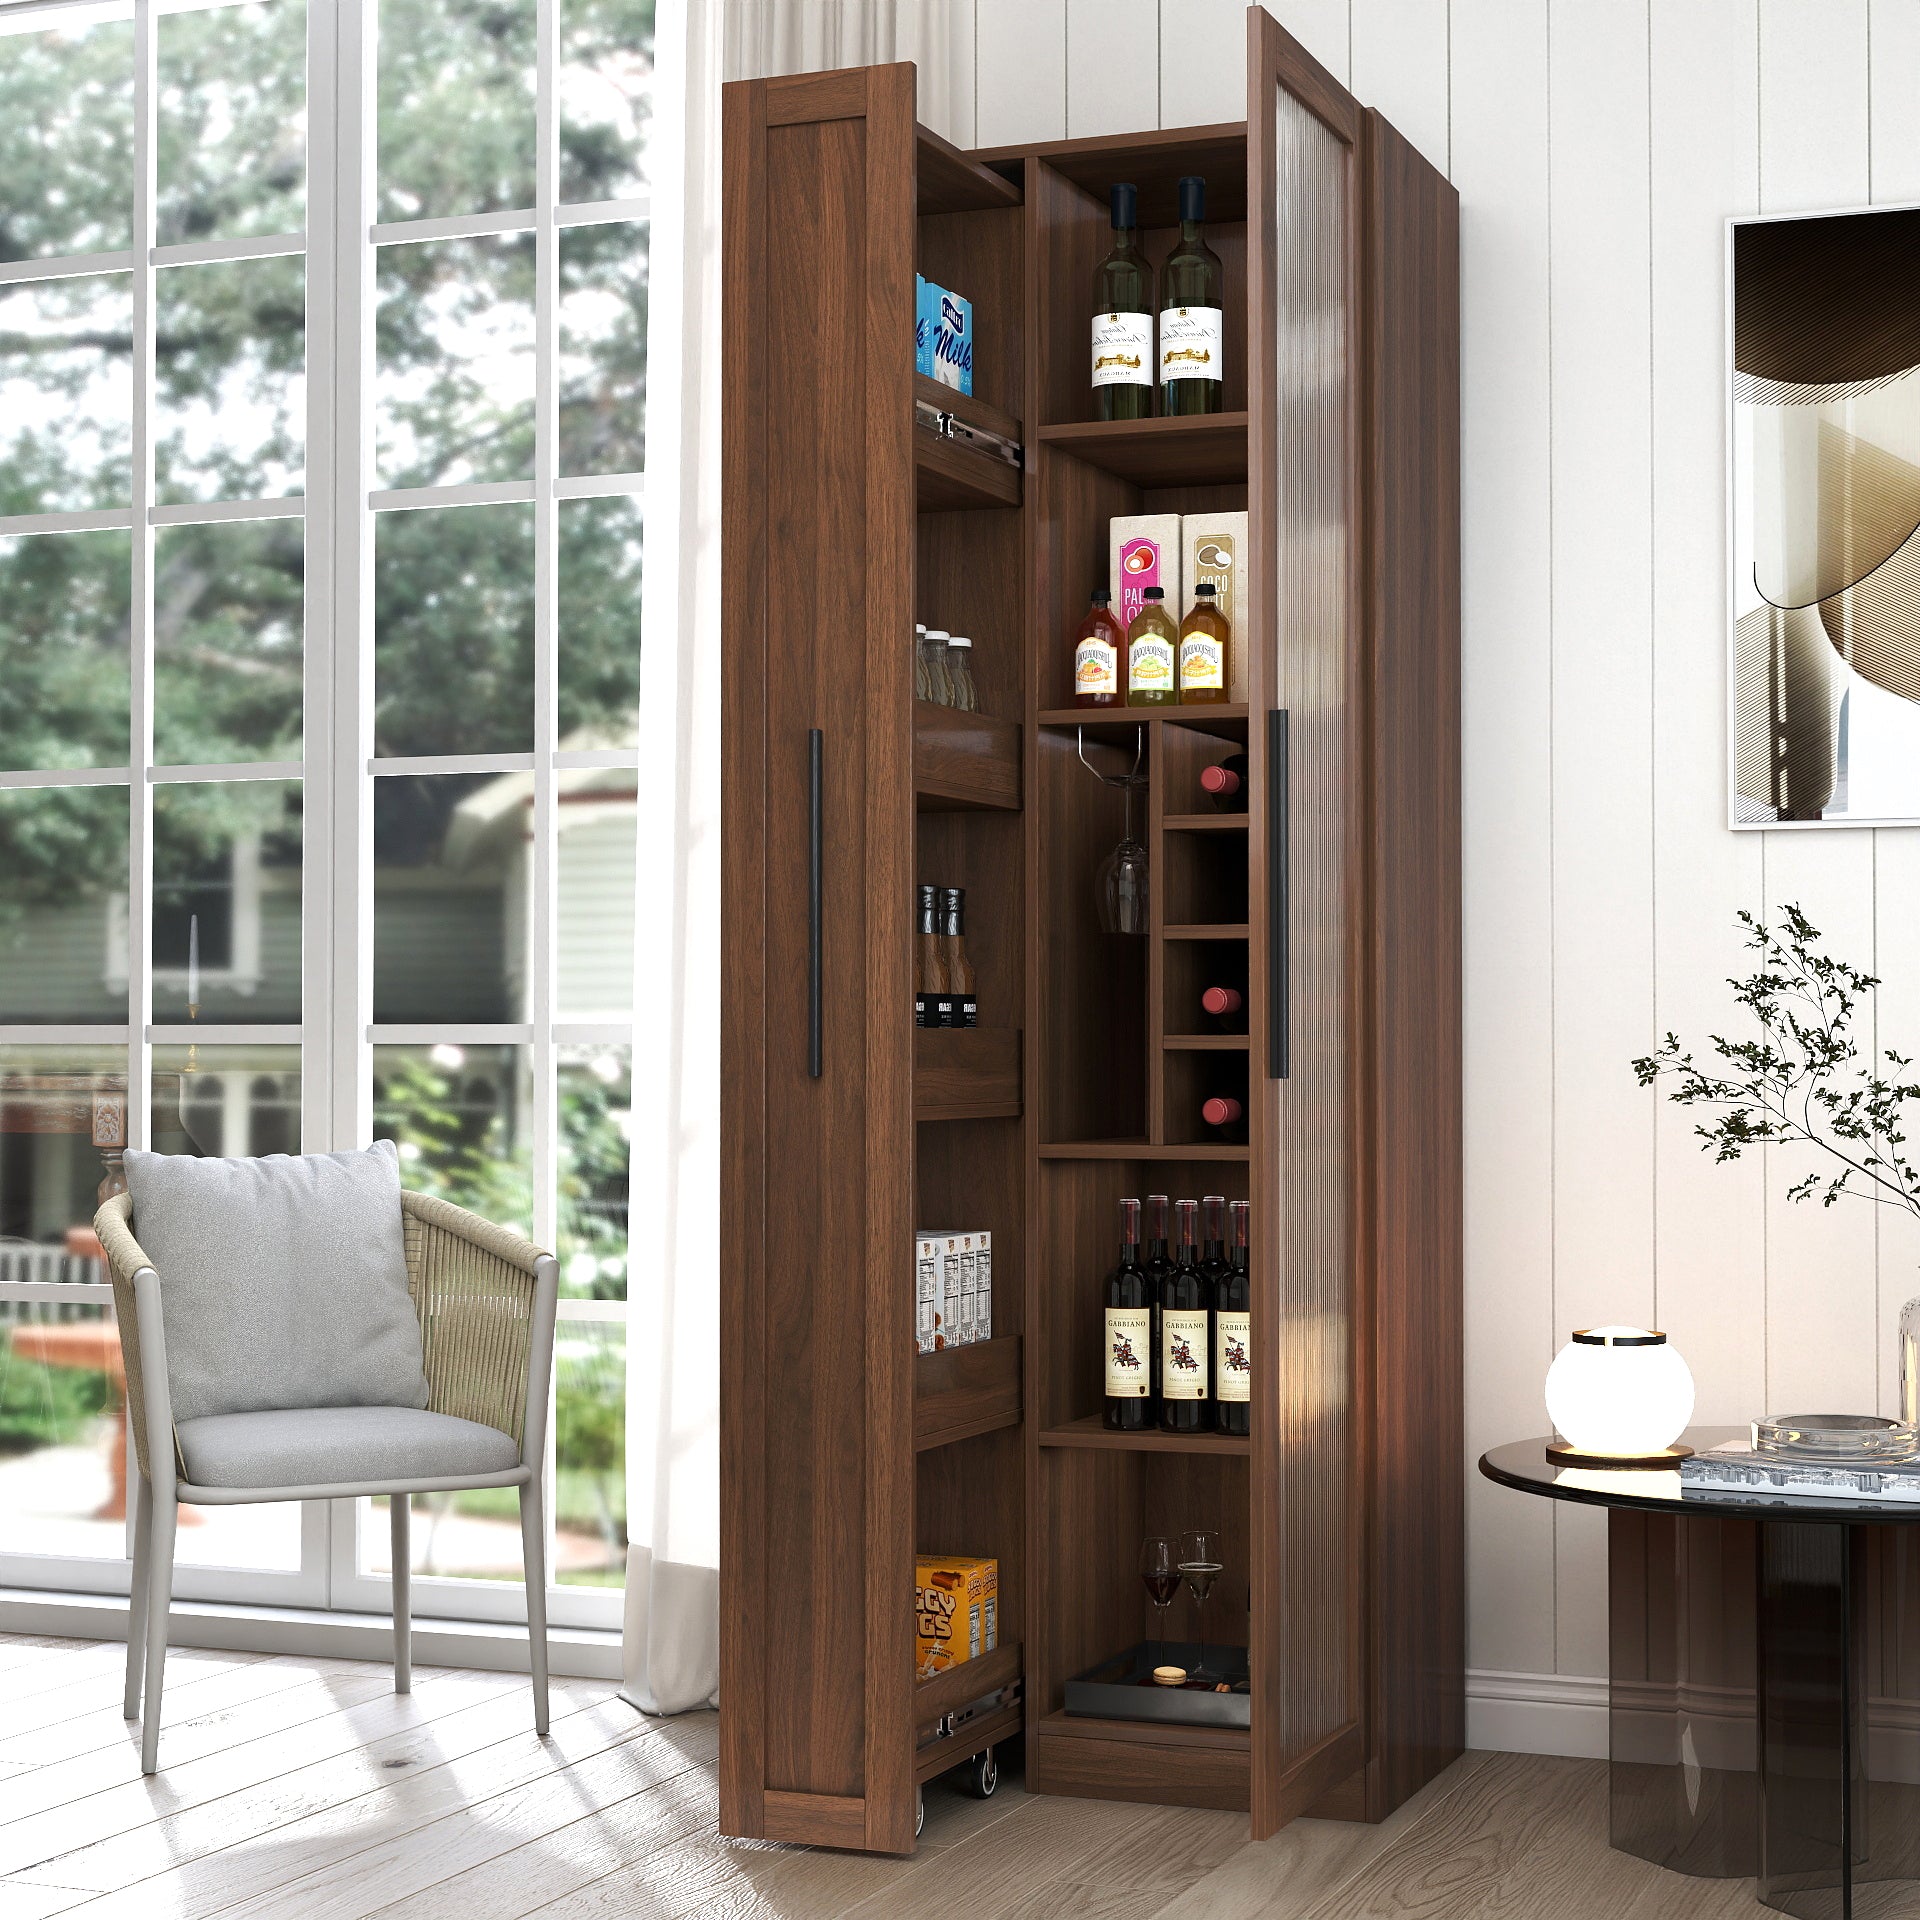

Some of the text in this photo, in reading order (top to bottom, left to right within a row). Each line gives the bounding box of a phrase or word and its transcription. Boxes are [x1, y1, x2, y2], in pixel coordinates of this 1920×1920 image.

[934, 324, 972, 372] Milk
[1125, 588, 1150, 605] PAL
[1165, 1321, 1204, 1329] GABBIANO
[1219, 1323, 1250, 1331] GABBIAN
